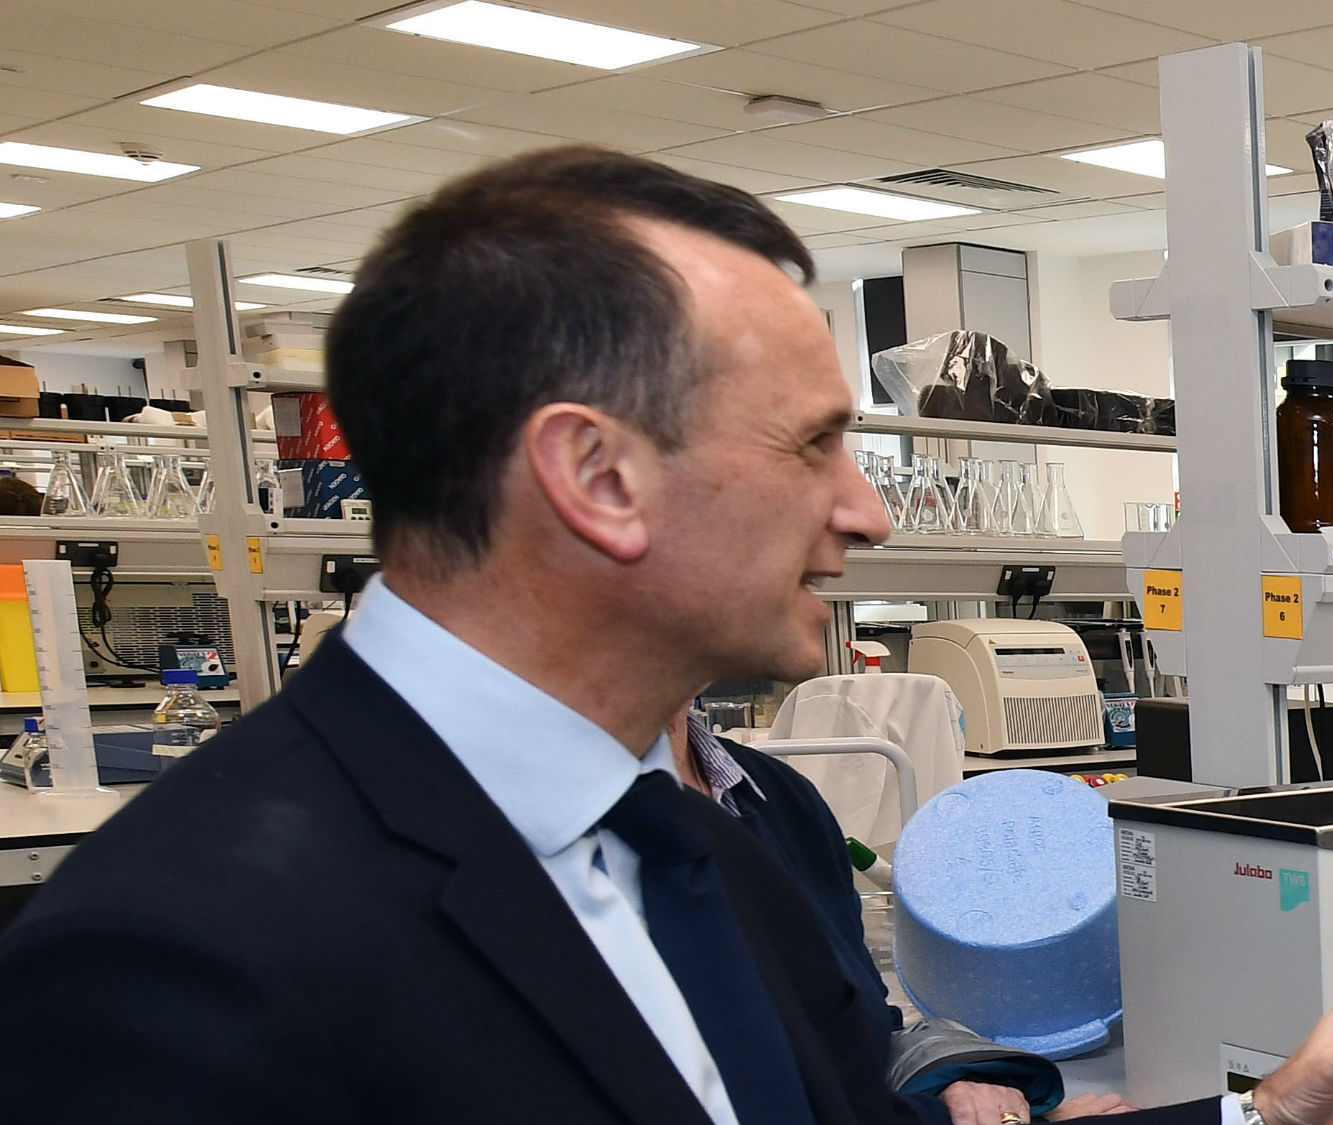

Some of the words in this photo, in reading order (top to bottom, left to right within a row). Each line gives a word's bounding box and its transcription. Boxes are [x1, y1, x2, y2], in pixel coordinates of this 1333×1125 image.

[1146, 585, 1172, 597] Phase
[1174, 587, 1179, 597] 2
[1264, 591, 1291, 603] Phase
[1293, 593, 1299, 604] 2
[1160, 604, 1166, 614] 7
[1279, 611, 1286, 621] 6
[1233, 862, 1273, 880] Julabo
